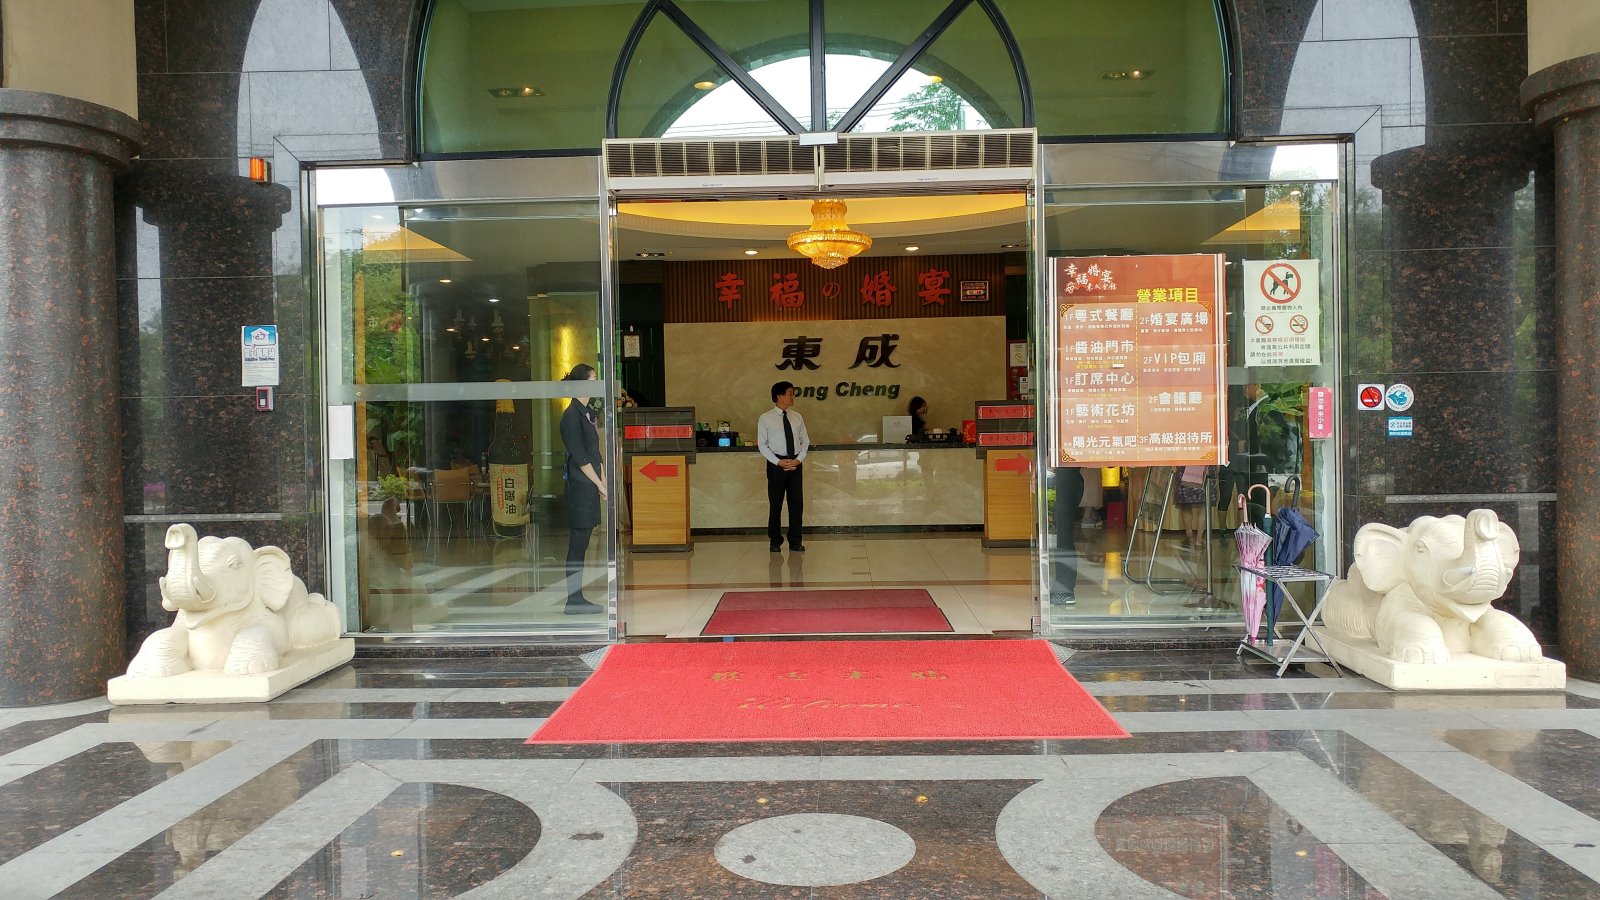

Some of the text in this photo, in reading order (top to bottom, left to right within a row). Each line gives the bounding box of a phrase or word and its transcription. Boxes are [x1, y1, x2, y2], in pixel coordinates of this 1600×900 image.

[714, 268, 952, 310] 幸福の婚宴
[1136, 288, 1198, 303] 營業項目
[775, 333, 901, 370] 東成
[793, 382, 901, 401] ong Cheng
